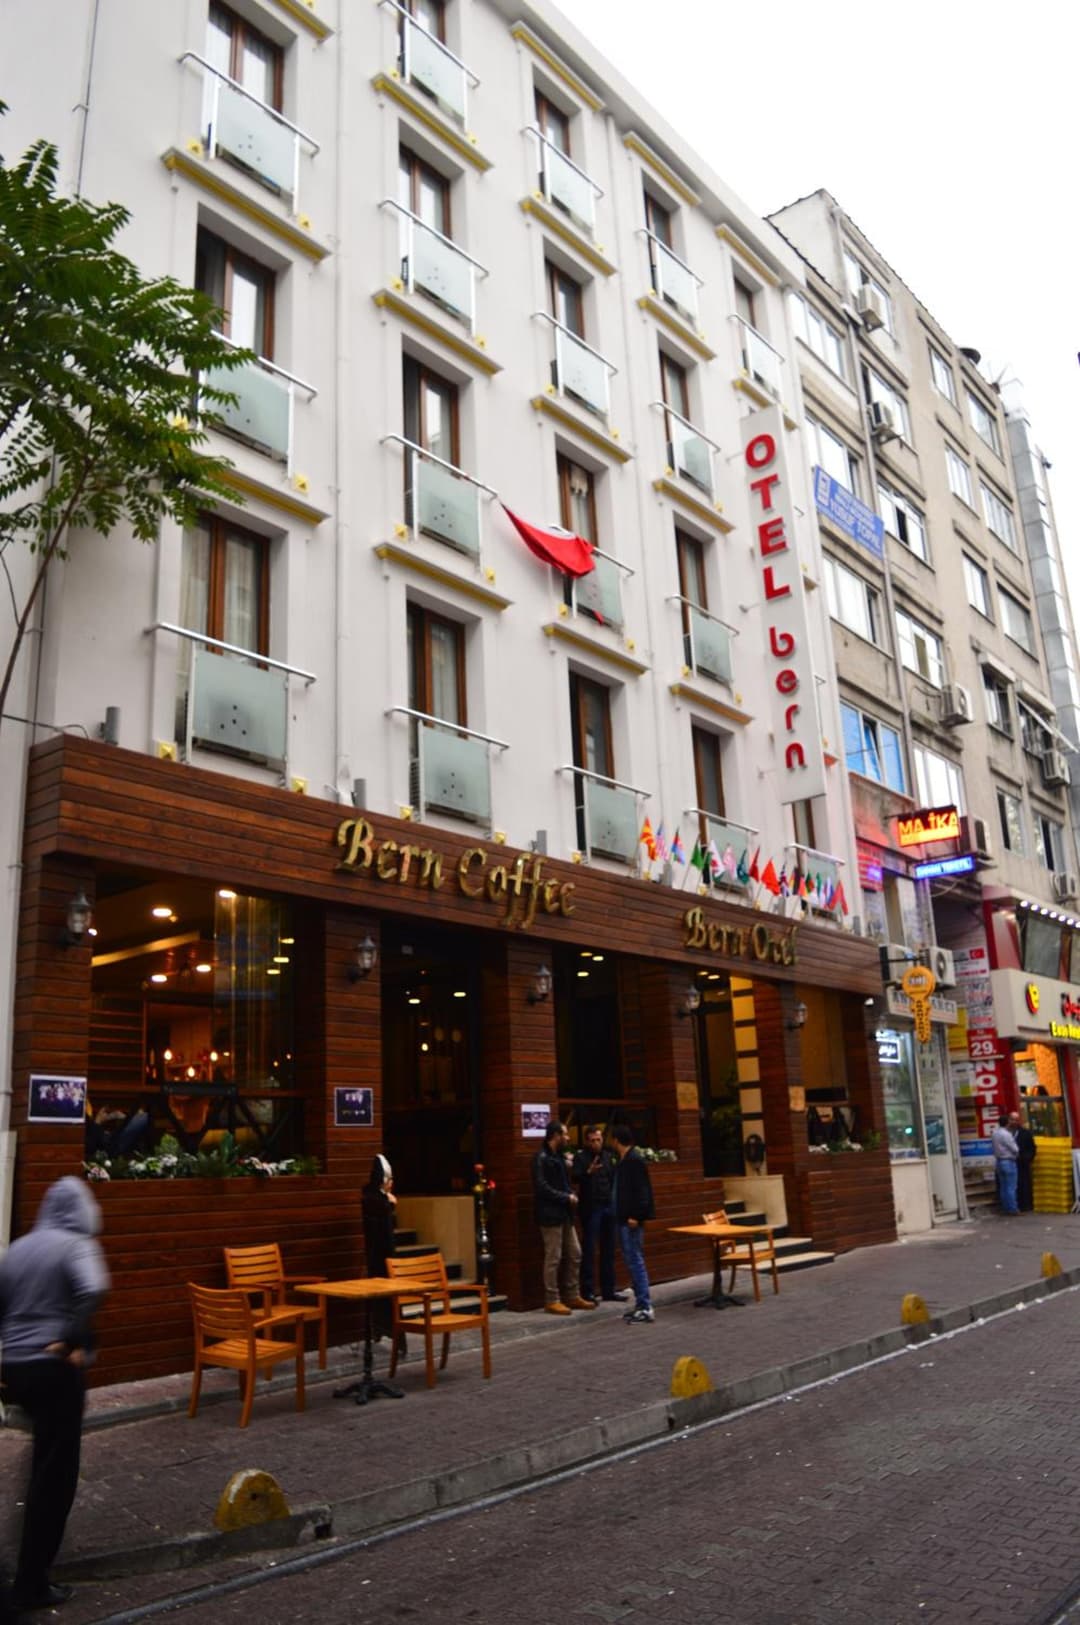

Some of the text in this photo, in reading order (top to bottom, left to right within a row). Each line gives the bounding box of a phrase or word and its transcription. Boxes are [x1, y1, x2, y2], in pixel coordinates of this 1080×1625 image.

[745, 433, 807, 771] OTEL bern
[336, 817, 576, 930] Bern Coffee
[684, 906, 750, 956] Bern
